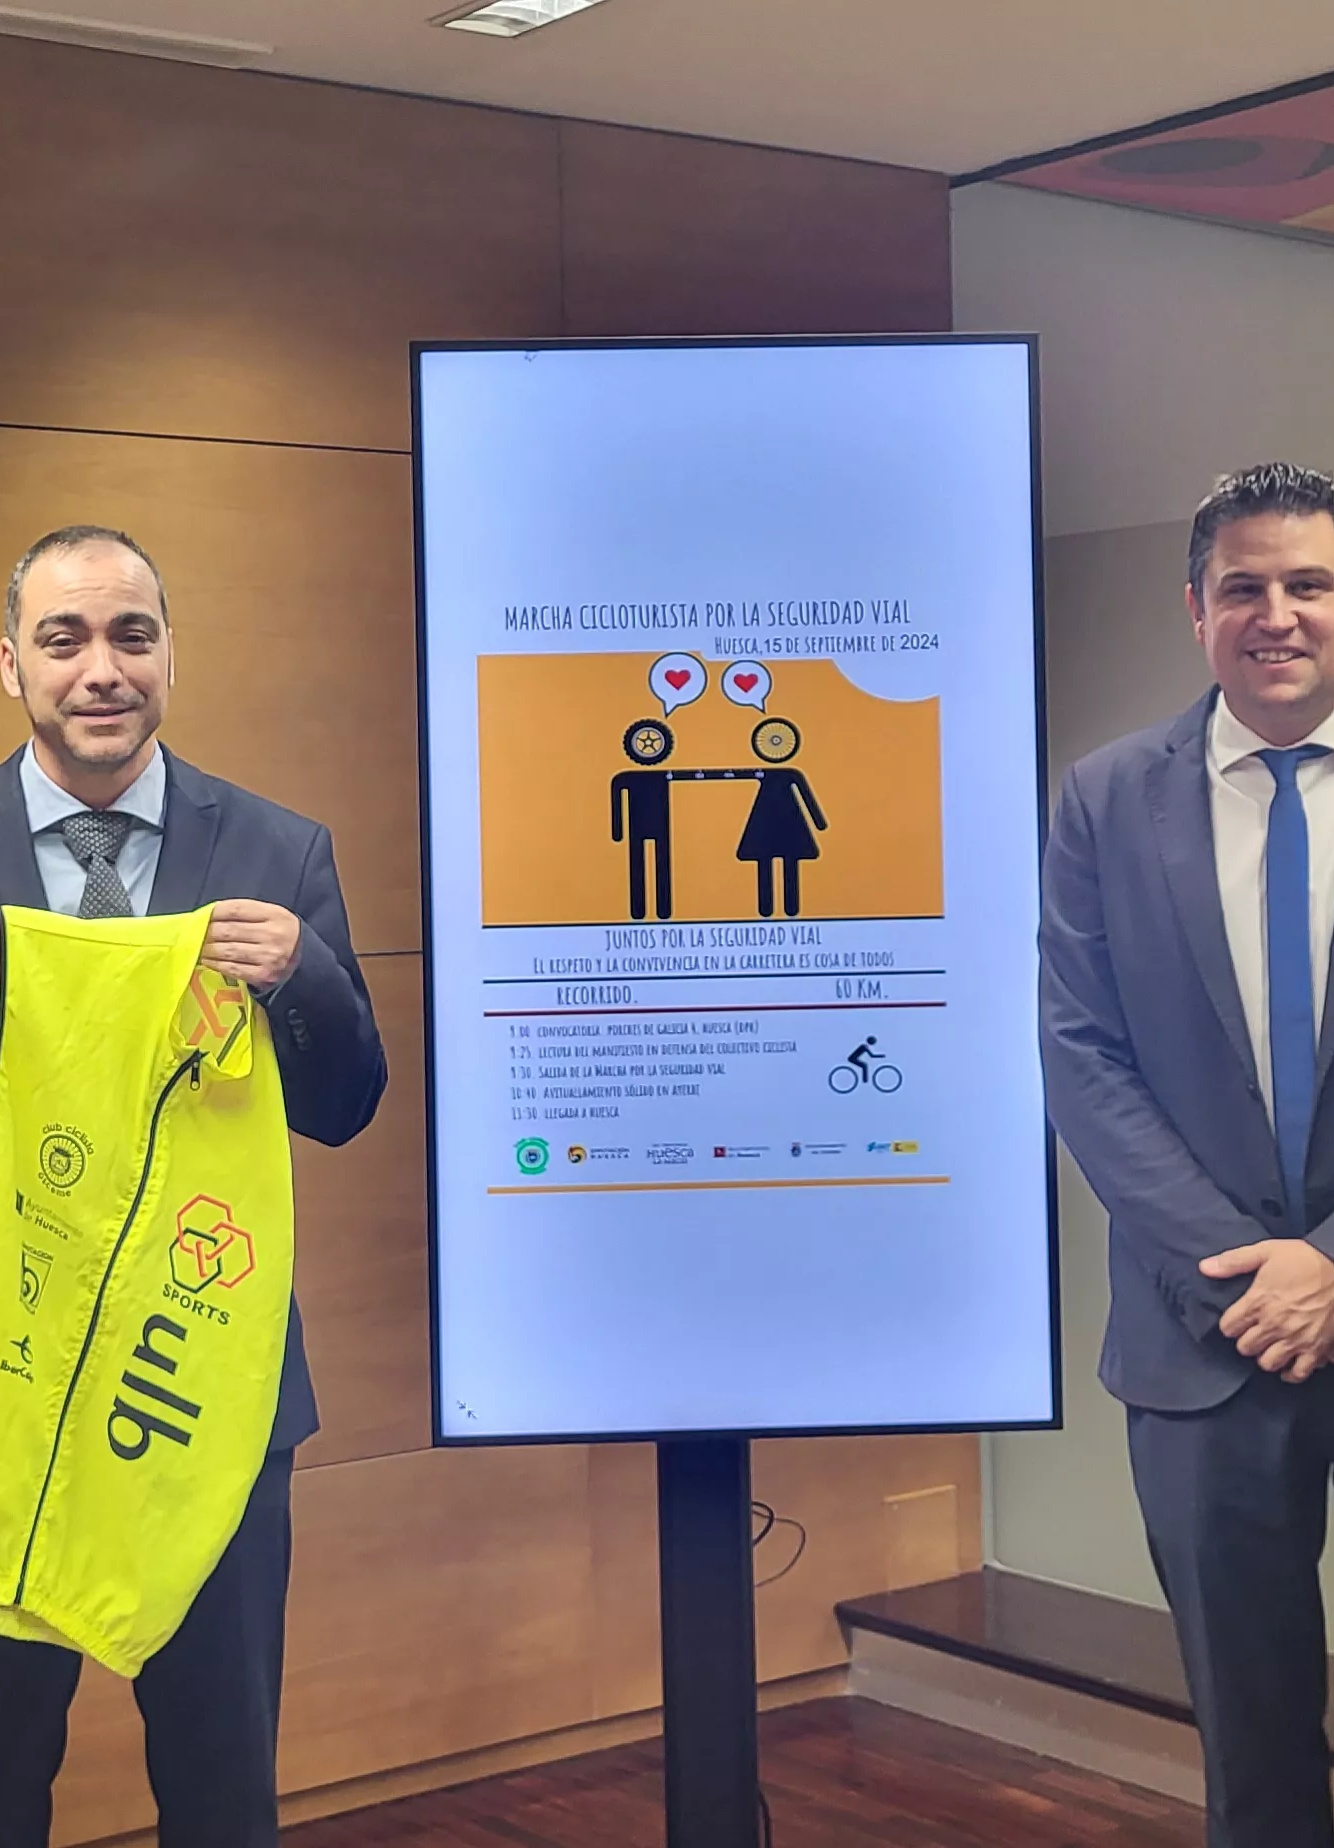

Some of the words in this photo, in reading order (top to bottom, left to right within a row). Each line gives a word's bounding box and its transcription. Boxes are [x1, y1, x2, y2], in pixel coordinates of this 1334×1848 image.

[505, 606, 572, 631] MARCHA
[580, 604, 698, 629] CICLOTURISTA
[706, 603, 735, 627] POR
[742, 602, 760, 627] LA
[767, 601, 864, 627] SEGURIDAD
[871, 599, 911, 624] VIAL
[786, 637, 799, 653] DE
[805, 636, 876, 653] SEPTIEMBRE
[881, 636, 894, 651] DE
[901, 634, 939, 650] 2024
[606, 929, 656, 951] JUNTOS
[662, 929, 685, 948] POR
[690, 928, 704, 948] LA
[710, 926, 786, 947] SEGURIDAD
[792, 926, 821, 945] VIAL
[550, 957, 592, 973] RESPETO
[596, 958, 601, 973] Y
[608, 958, 618, 972] LA
[622, 956, 699, 972] CONVIVENCIA
[705, 956, 719, 970] EN
[724, 955, 736, 969] LA
[740, 954, 795, 969] CARRETERA
[799, 954, 810, 968] ES
[815, 952, 839, 967] COSA
[844, 952, 855, 967] DE
[861, 951, 894, 967] TODOS
[557, 985, 638, 1005] RECORRIDO.
[836, 979, 851, 999] 60
[43, 1123, 62, 1134] club
[66, 1125, 94, 1155] ciclista
[35, 1215, 68, 1240] Huesca
[163, 1284, 230, 1325] SPORTS
